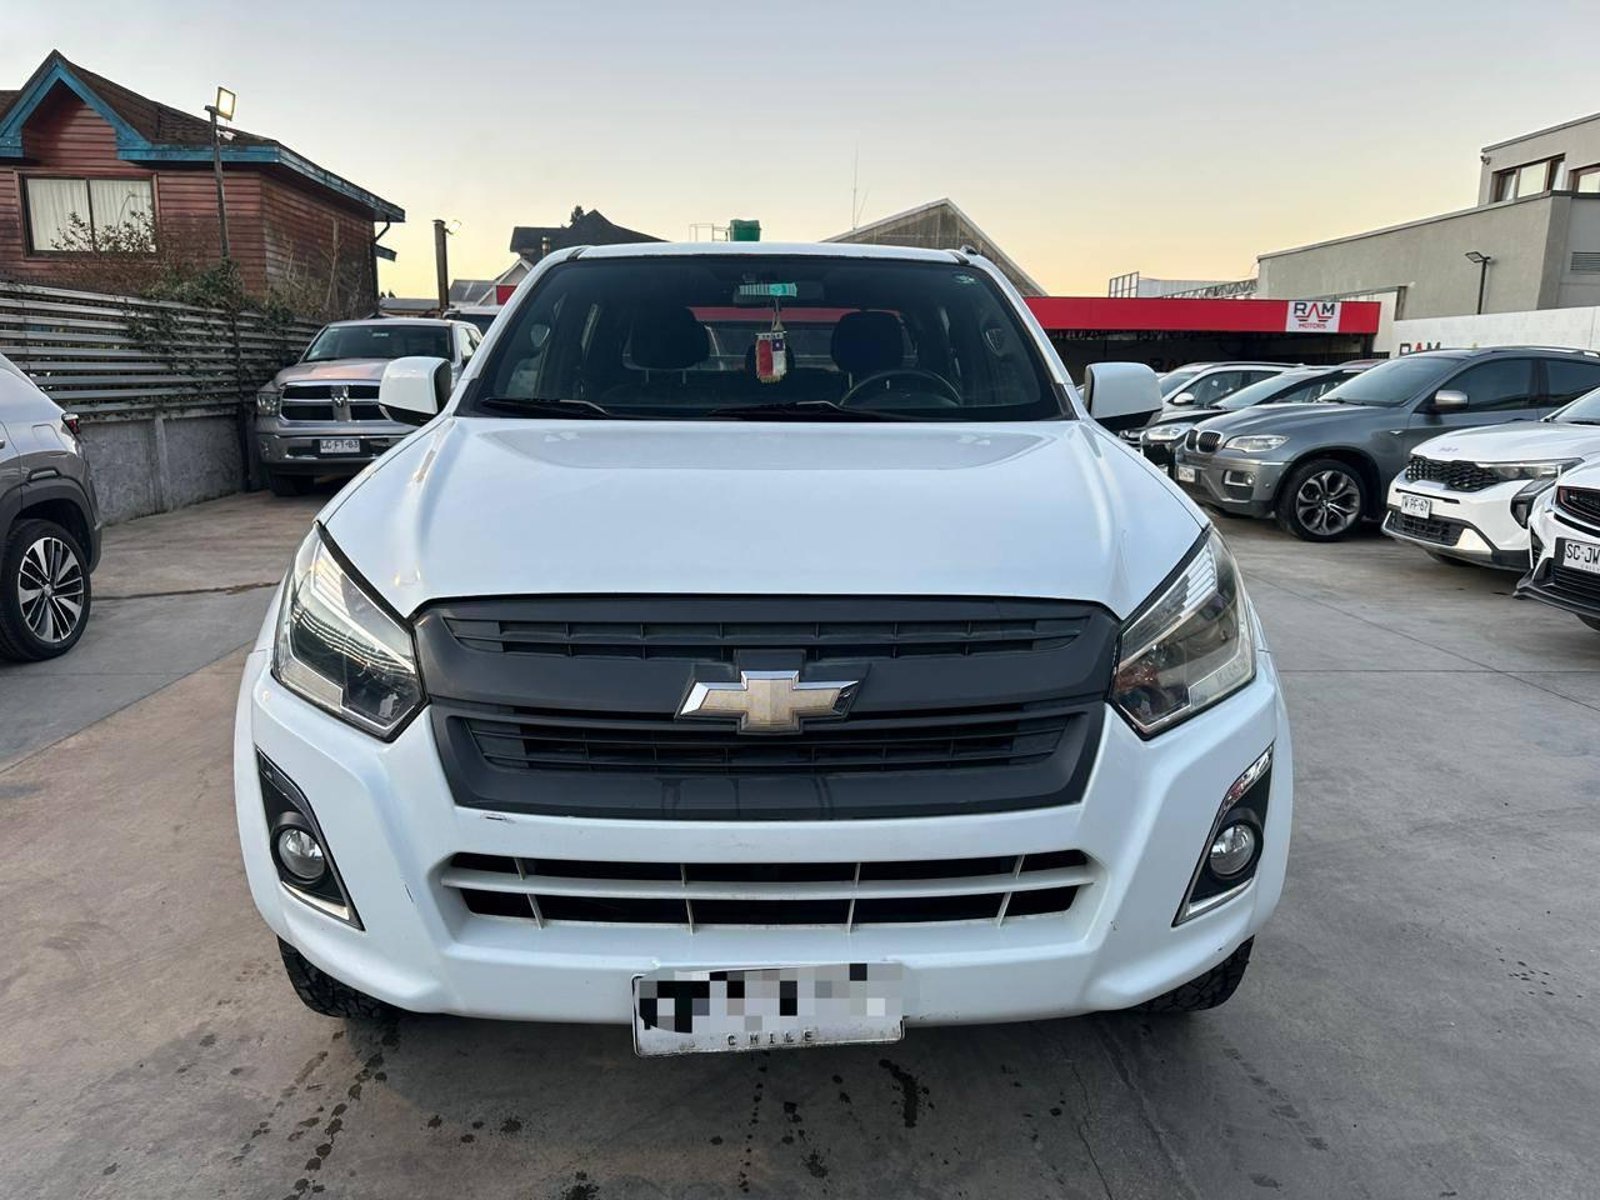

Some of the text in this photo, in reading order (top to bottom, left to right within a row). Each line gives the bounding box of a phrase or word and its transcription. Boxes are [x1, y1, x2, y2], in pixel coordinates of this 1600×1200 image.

[1293, 302, 1336, 317] RAM
[1298, 322, 1328, 330] MOTORS
[727, 1030, 814, 1046] CHILE
